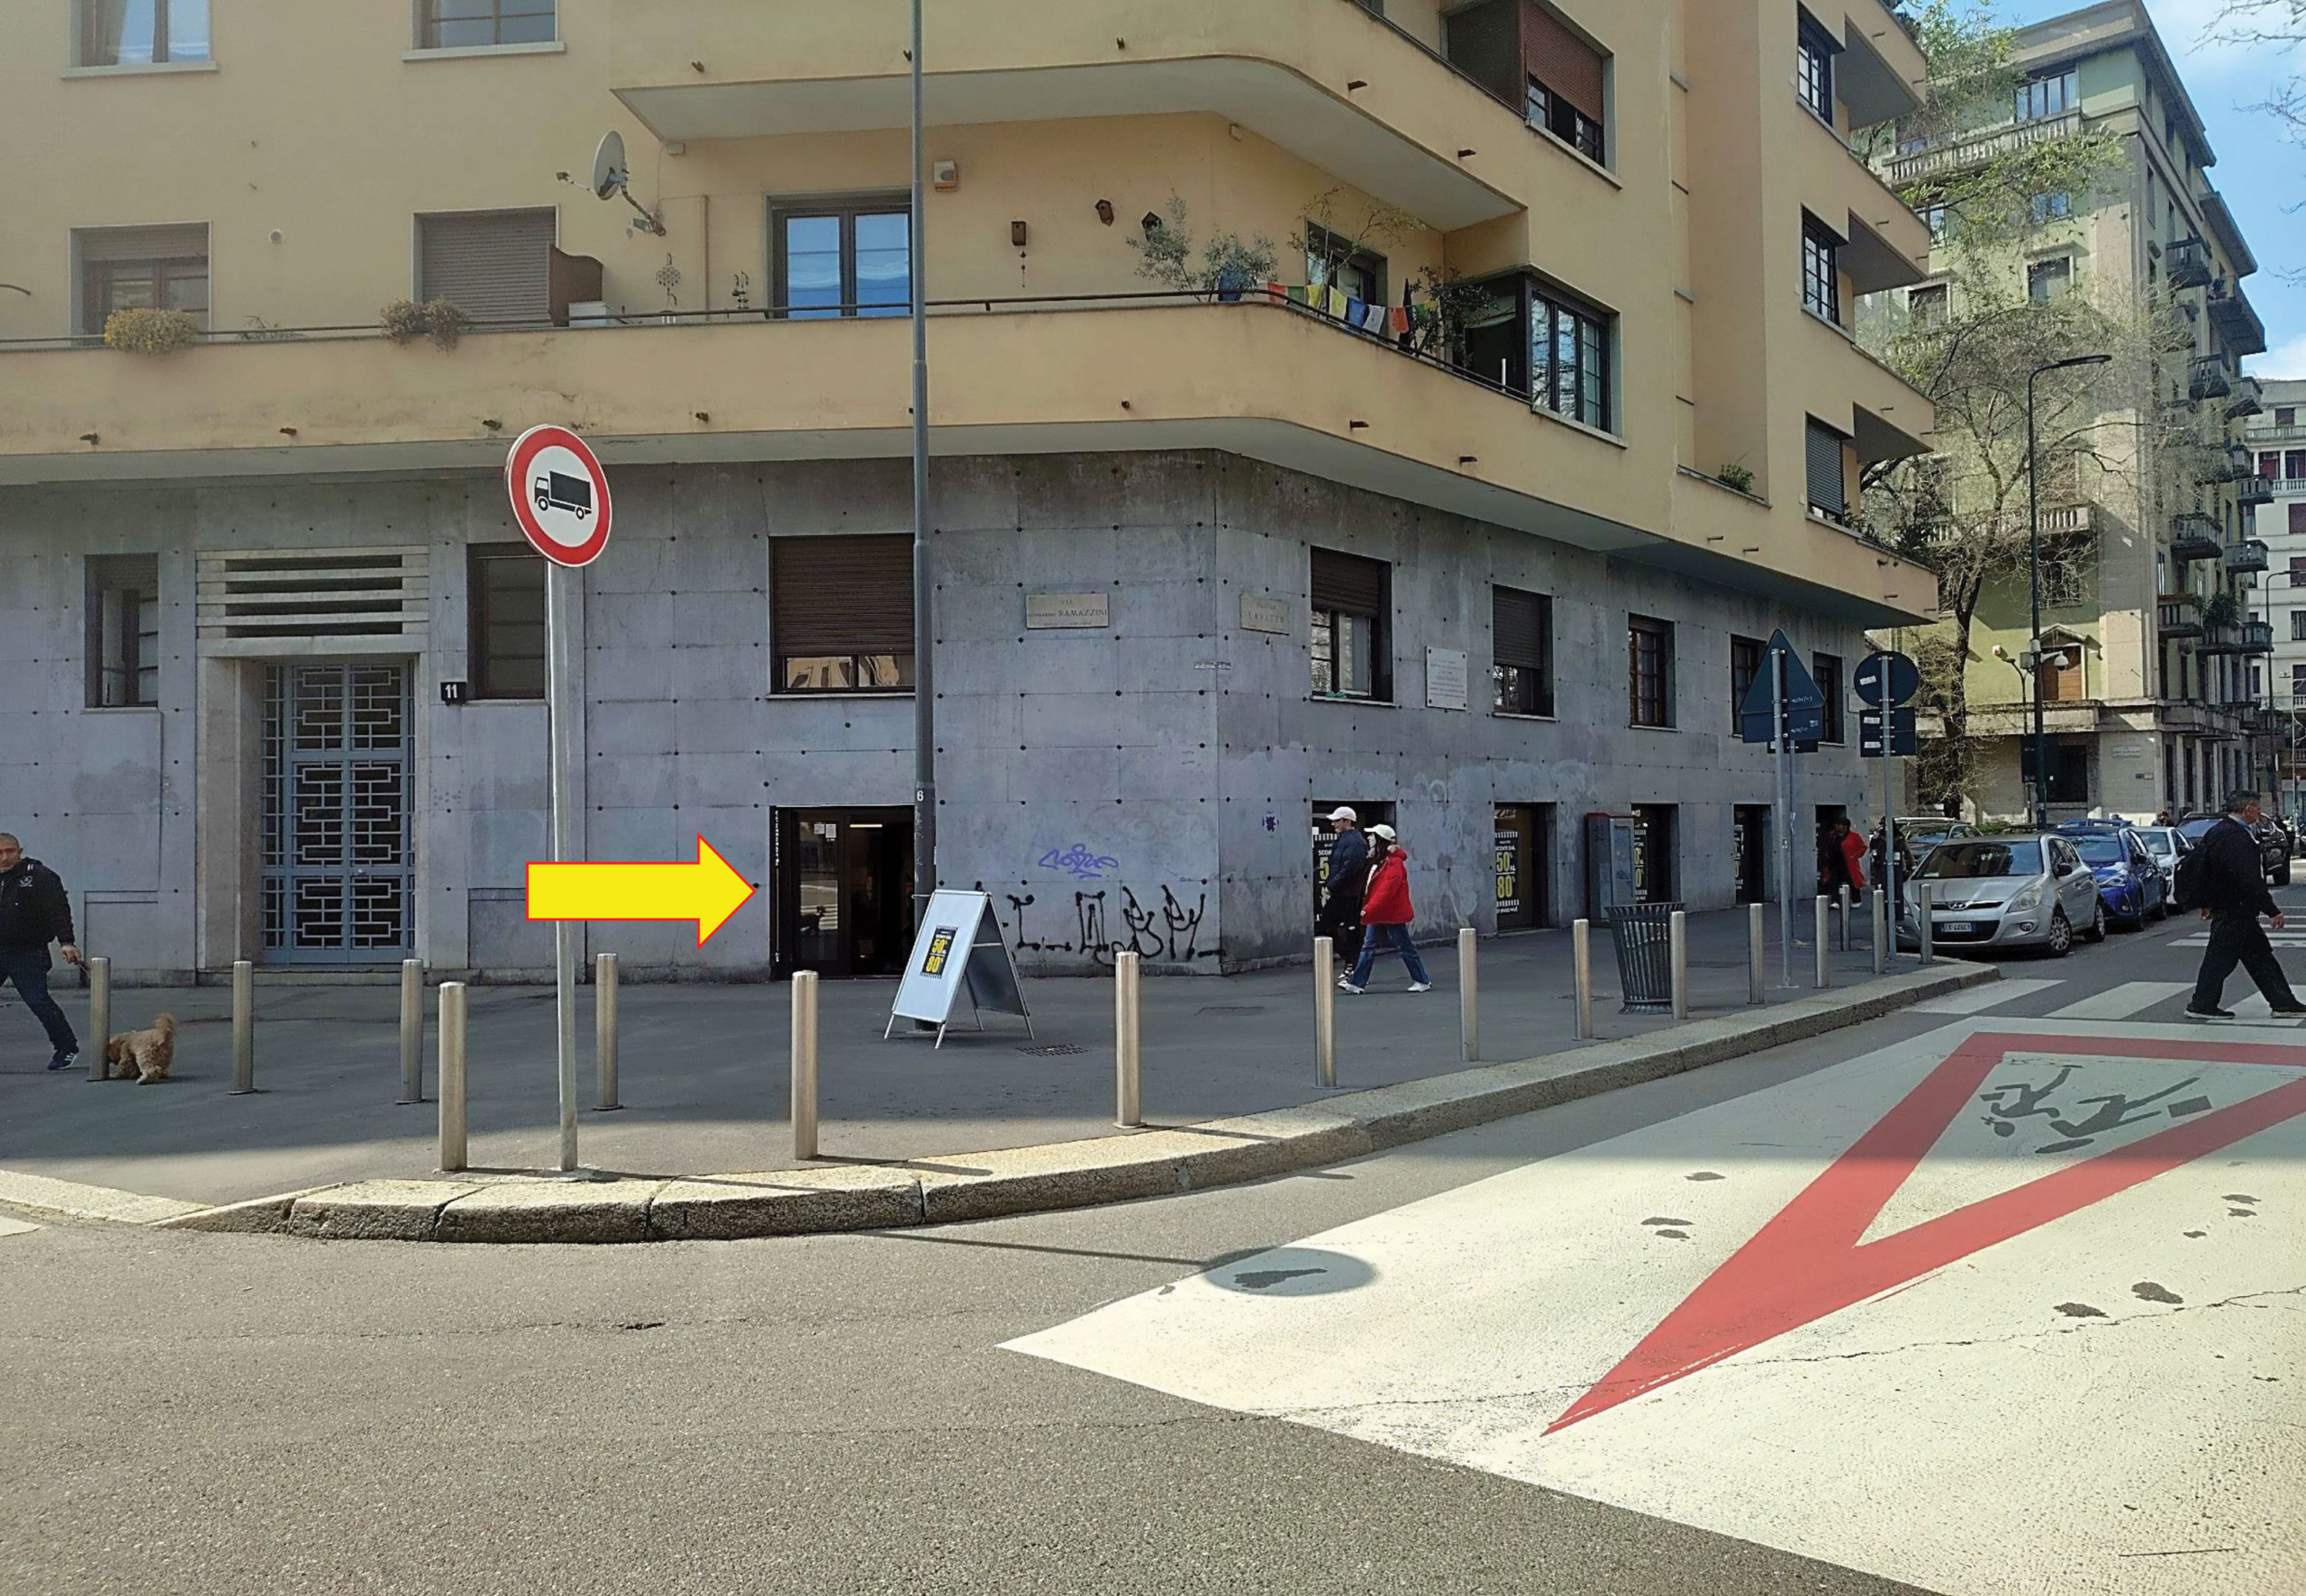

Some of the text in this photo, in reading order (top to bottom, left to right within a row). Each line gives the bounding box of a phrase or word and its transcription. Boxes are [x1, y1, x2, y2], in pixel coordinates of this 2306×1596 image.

[1058, 609, 1107, 617] RAMAZZINI
[445, 684, 457, 698] 11
[917, 790, 923, 802] 6
